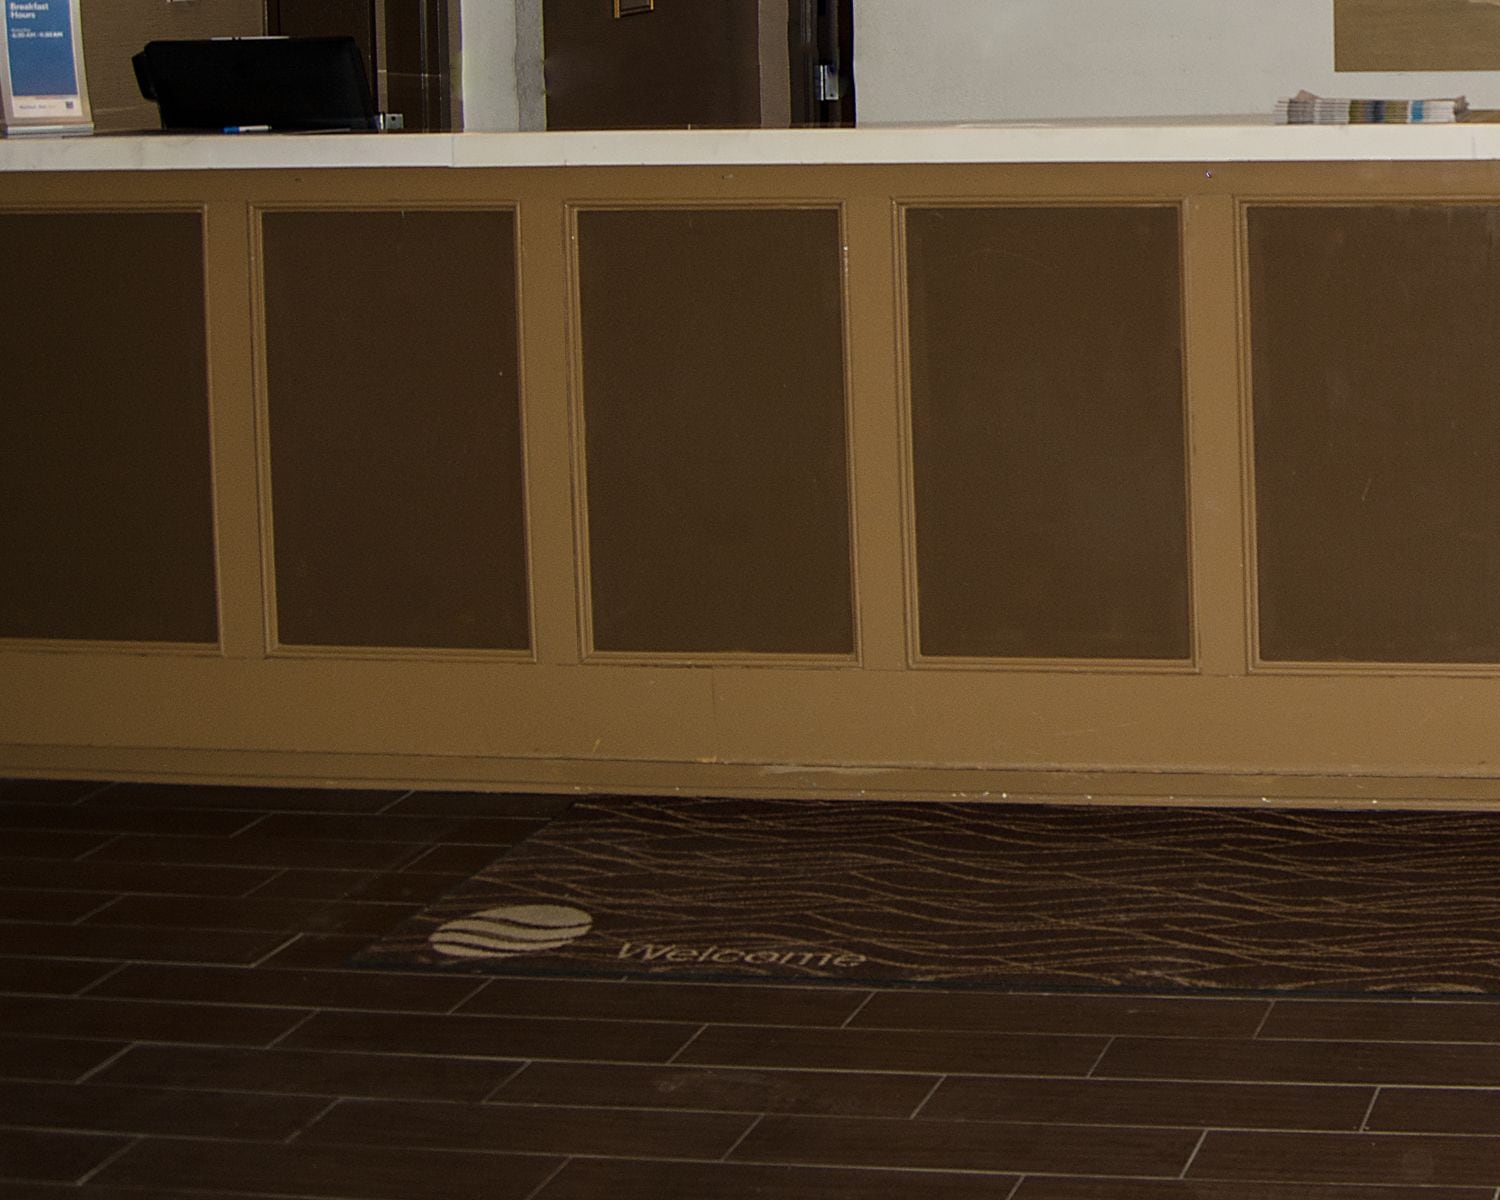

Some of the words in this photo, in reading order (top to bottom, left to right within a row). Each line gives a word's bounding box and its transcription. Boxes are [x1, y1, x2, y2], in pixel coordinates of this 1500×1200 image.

[11, 2, 49, 11] Breakfast
[11, 11, 36, 20] Hours
[617, 942, 867, 968] Welcome
